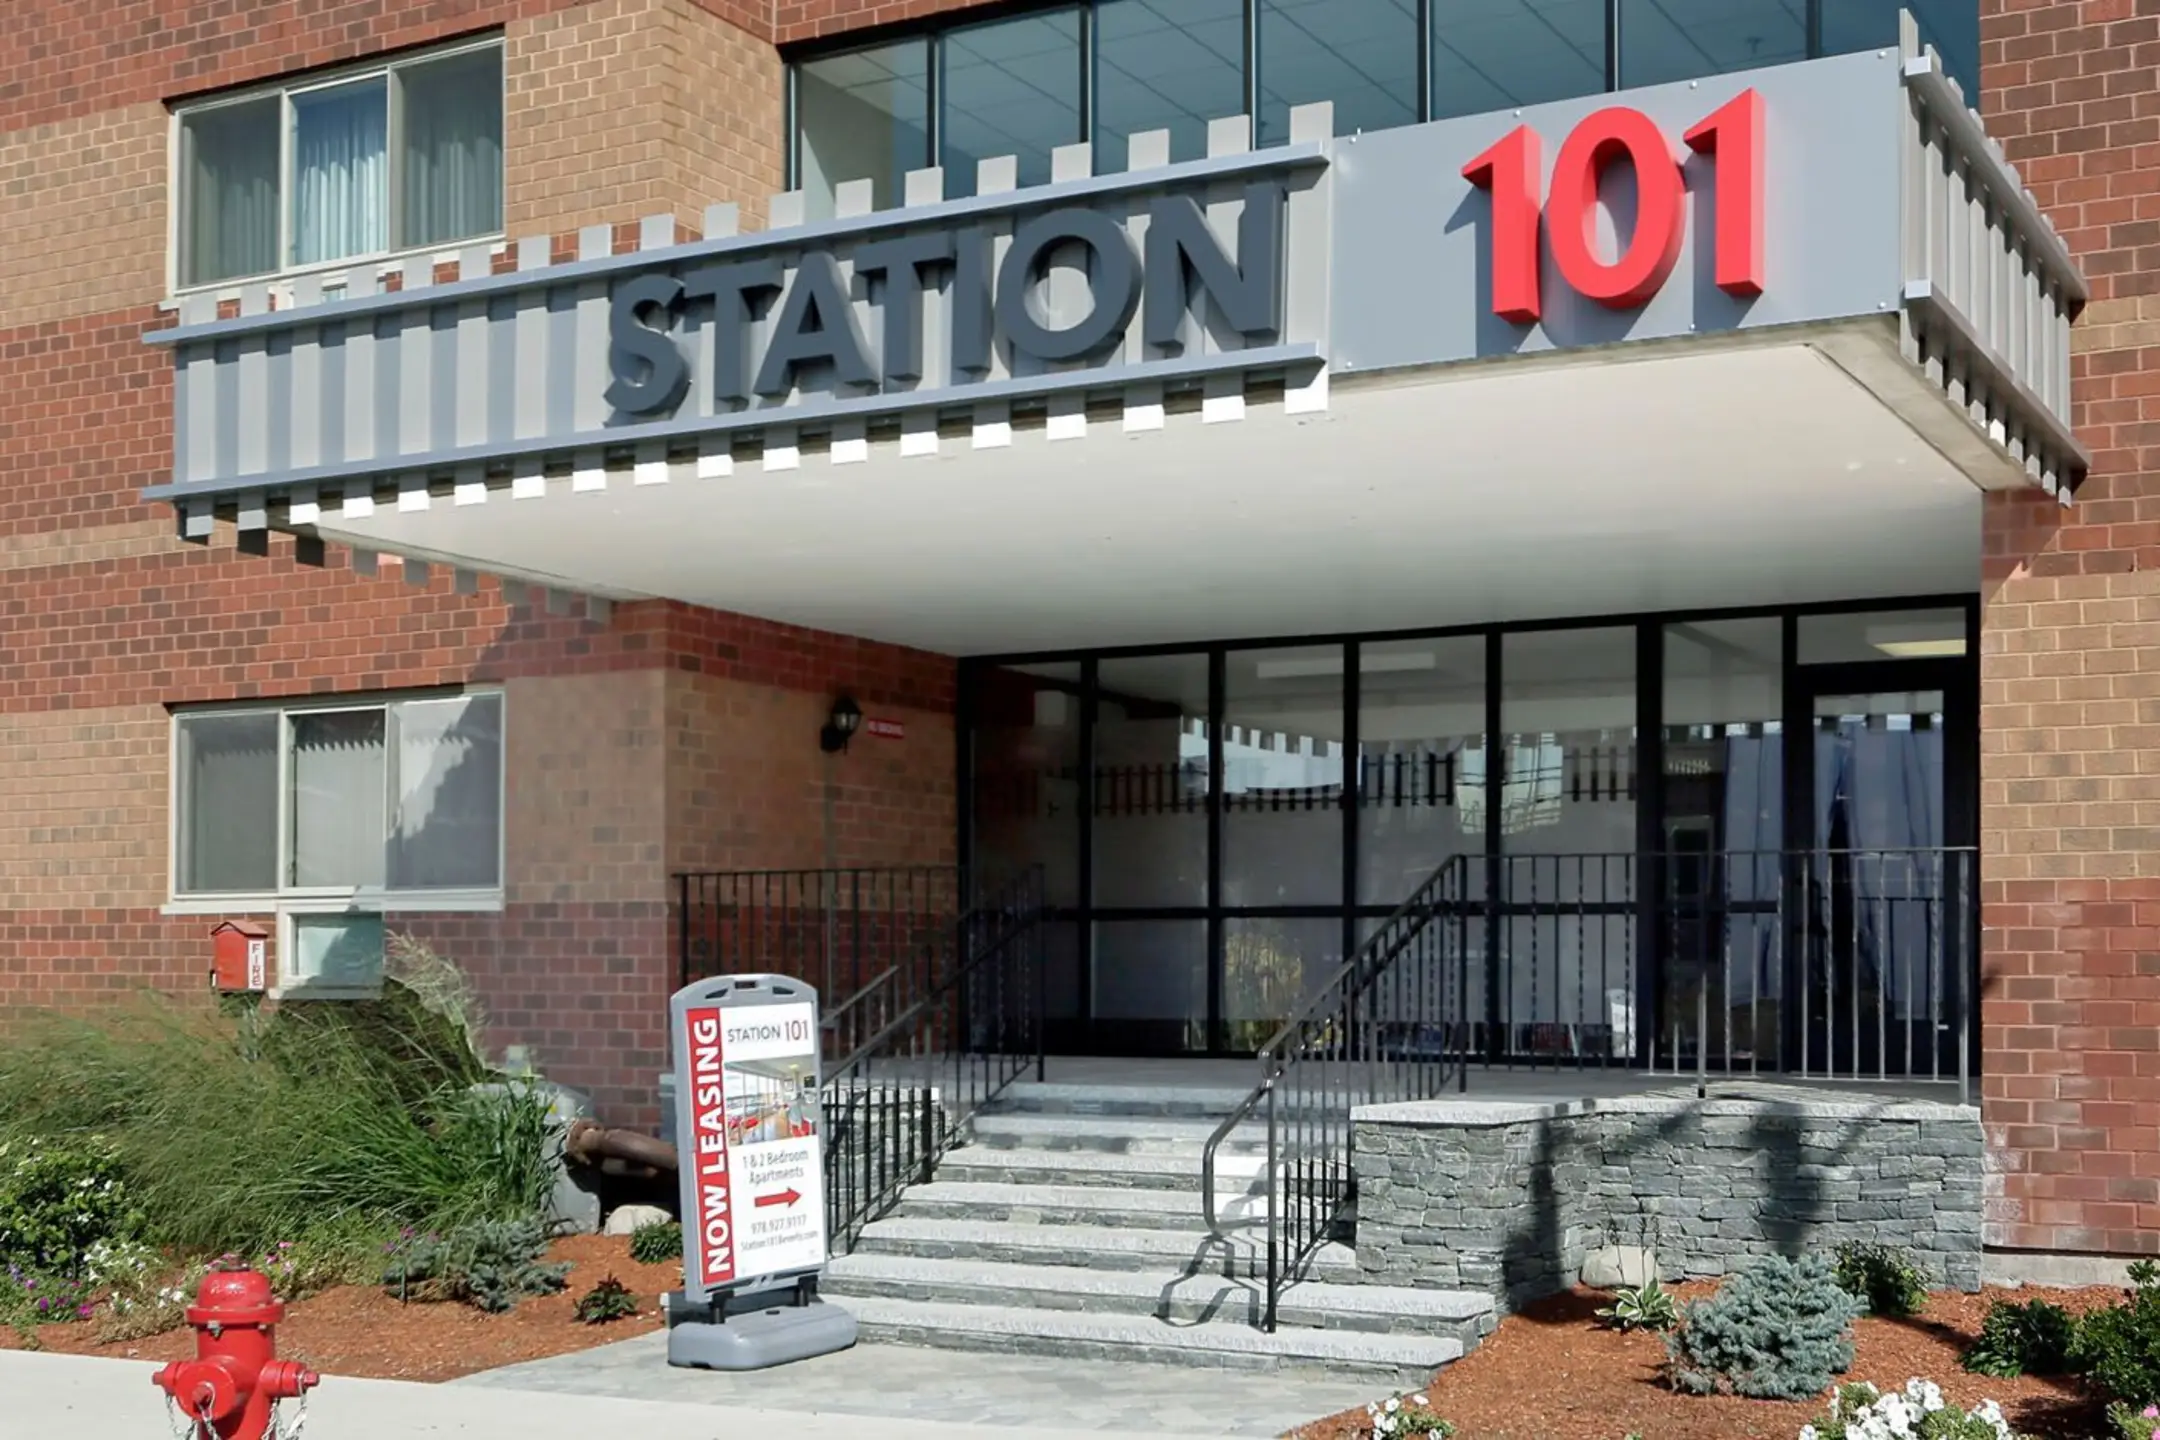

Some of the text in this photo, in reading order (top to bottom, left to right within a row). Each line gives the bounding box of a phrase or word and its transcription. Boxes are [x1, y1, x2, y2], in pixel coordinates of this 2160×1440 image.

[603, 87, 1766, 413] STATION 101
[252, 943, 262, 986] FIRE
[727, 1019, 809, 1043] STATION 101
[694, 1018, 731, 1275] NOW LEASING
[750, 1154, 757, 1168] &
[767, 1149, 809, 1165] Bedroom
[749, 1166, 804, 1187] Apartments
